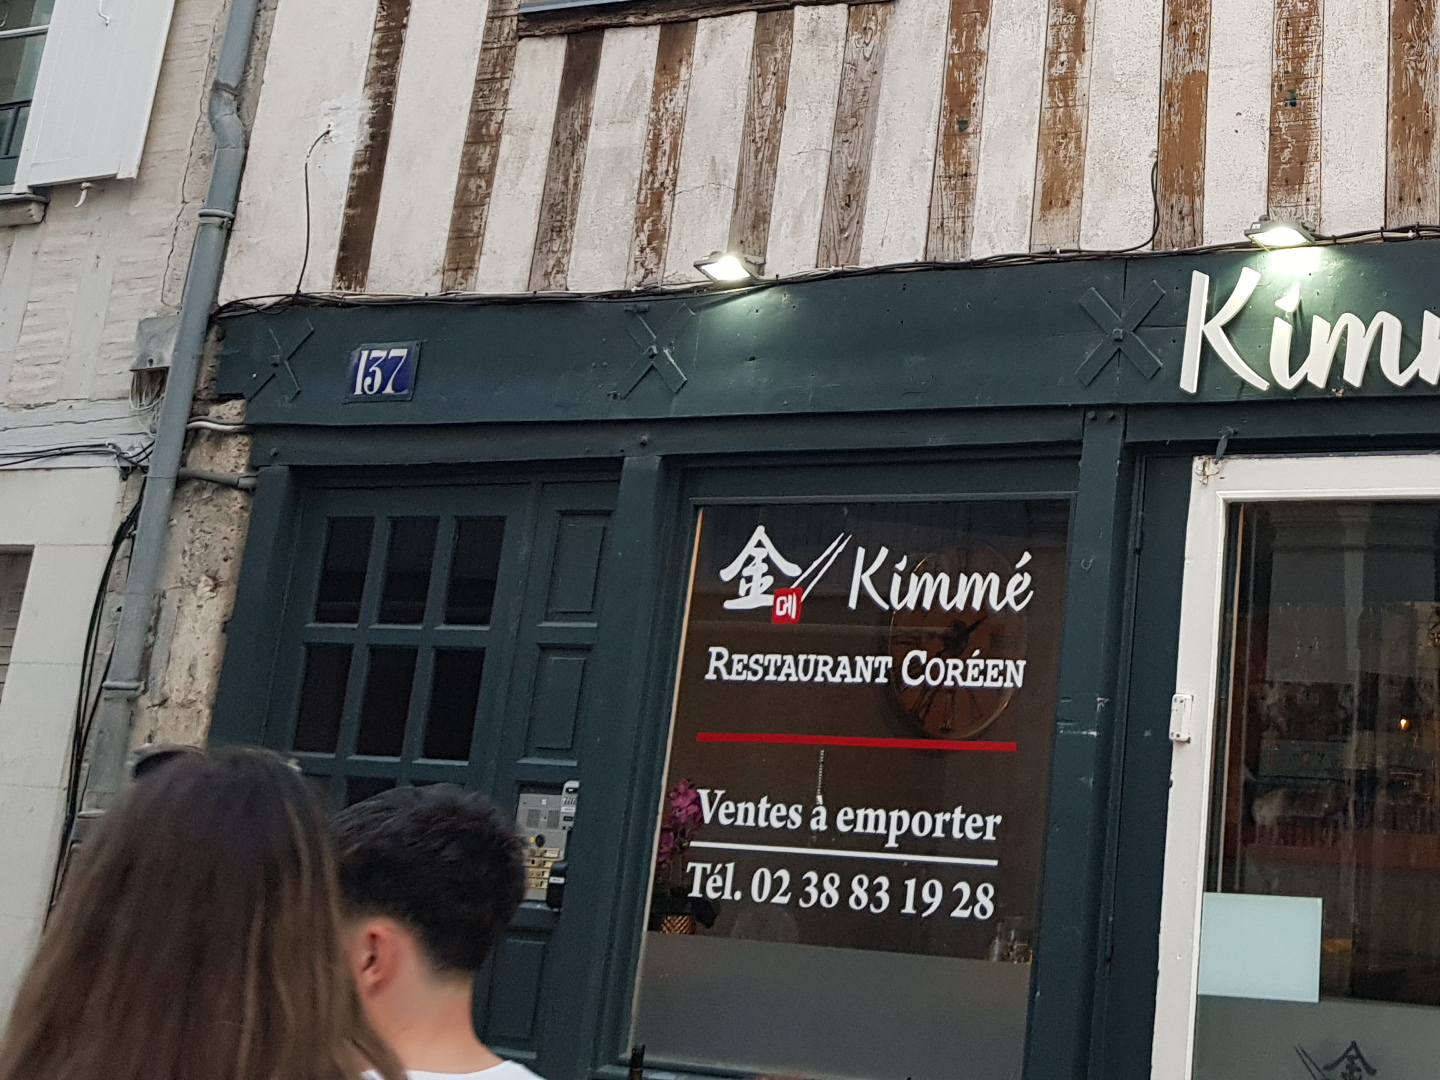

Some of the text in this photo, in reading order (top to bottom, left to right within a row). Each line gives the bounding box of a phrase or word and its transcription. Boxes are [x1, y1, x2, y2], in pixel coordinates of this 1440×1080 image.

[353, 347, 408, 397] 137
[719, 524, 802, 610] 金
[848, 546, 1034, 614] Kimmé
[696, 788, 803, 830] Ventes
[836, 805, 1003, 848] emporter
[686, 862, 996, 920] Tél. 02 38 83 19 28
